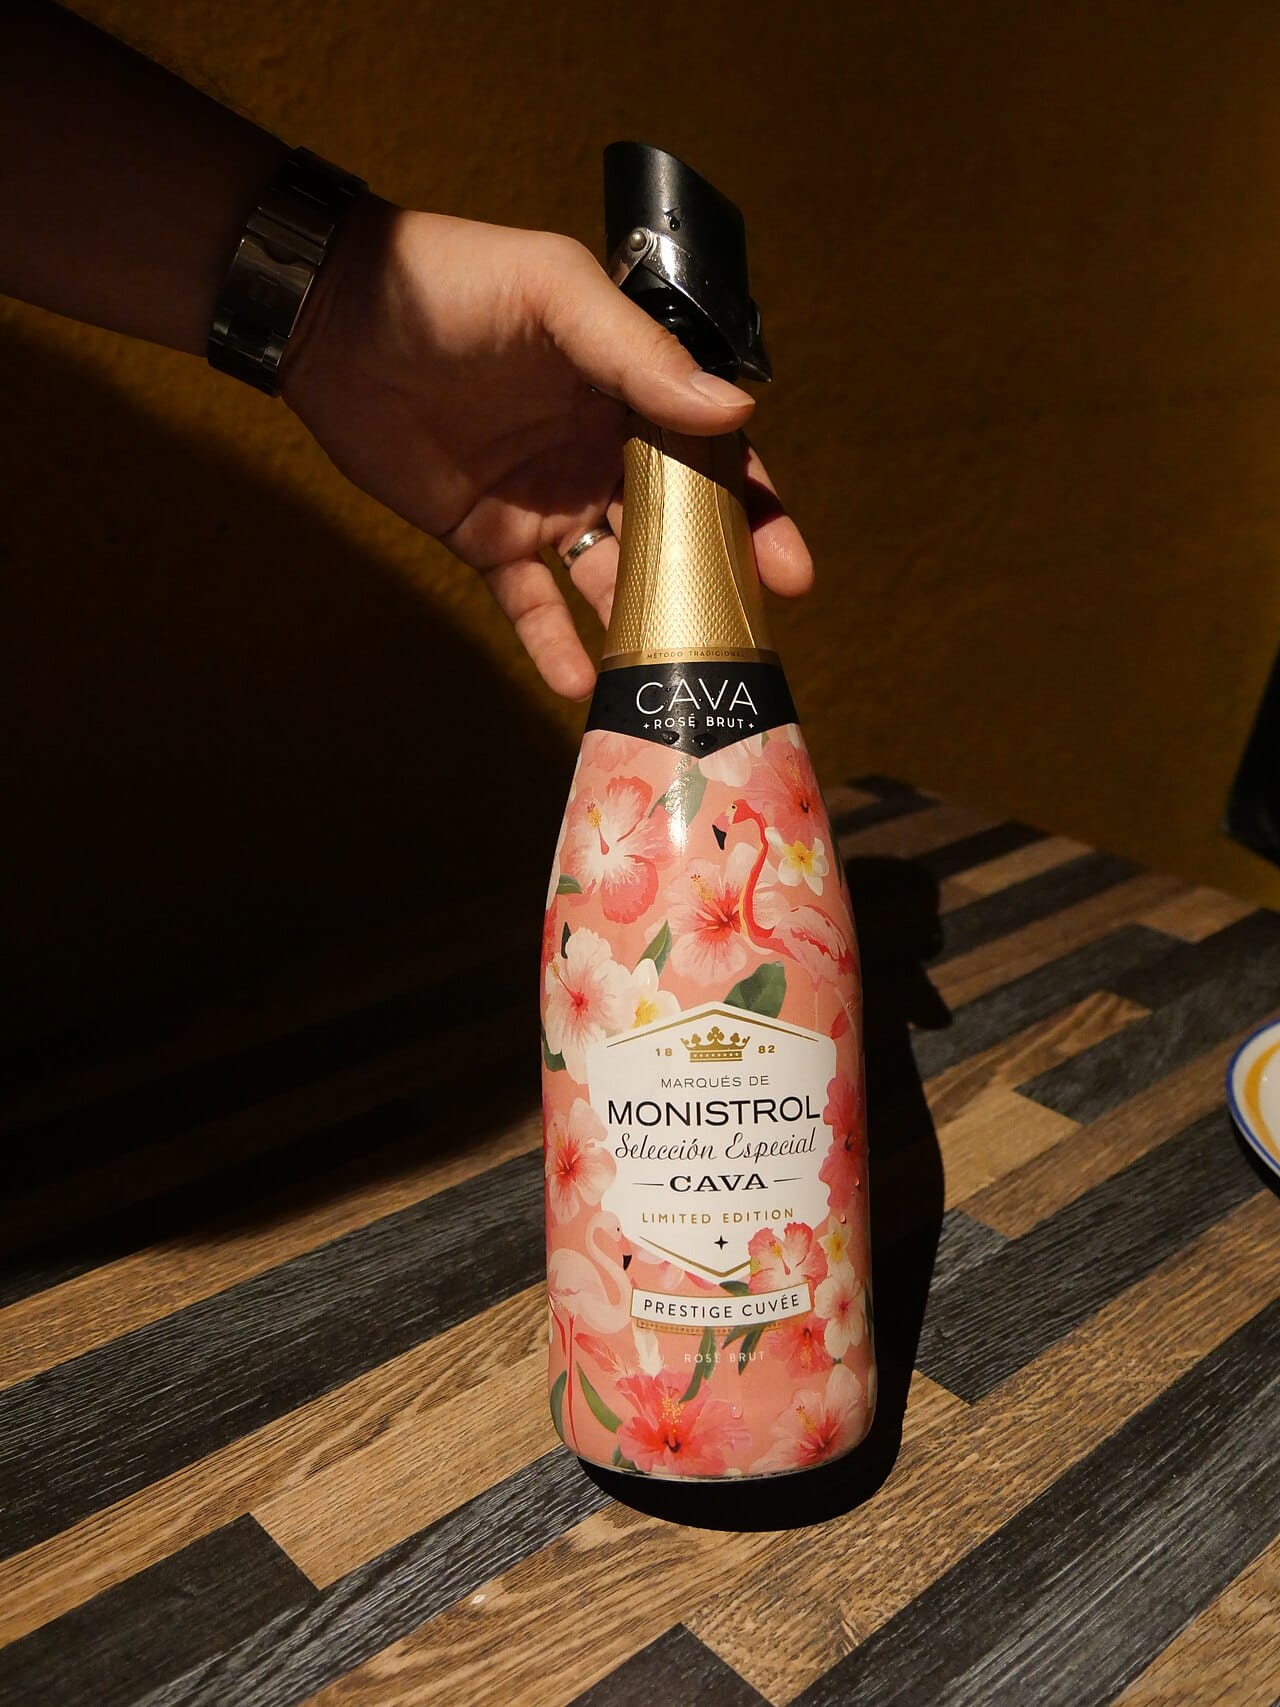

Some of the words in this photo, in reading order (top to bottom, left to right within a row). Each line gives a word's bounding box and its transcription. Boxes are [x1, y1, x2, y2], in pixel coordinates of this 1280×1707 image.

[636, 678, 758, 715] CAVA
[654, 713, 696, 730] ROSÉ
[706, 716, 744, 729] BRUT
[655, 1048, 673, 1057] 18
[758, 1045, 775, 1054] 82
[661, 1075, 742, 1089] MARQUÉS
[749, 1075, 769, 1086] DE
[608, 1095, 820, 1127] MONISTROL
[615, 1132, 717, 1160] Selección
[725, 1127, 816, 1164] Especial
[669, 1173, 768, 1192] CAVA
[641, 1212, 711, 1224] LIMITED
[722, 1208, 794, 1224] EDITION
[644, 1299, 732, 1319] PRESTIGE
[742, 1294, 800, 1316] CUVÉE
[730, 1351, 765, 1362] BRUT
